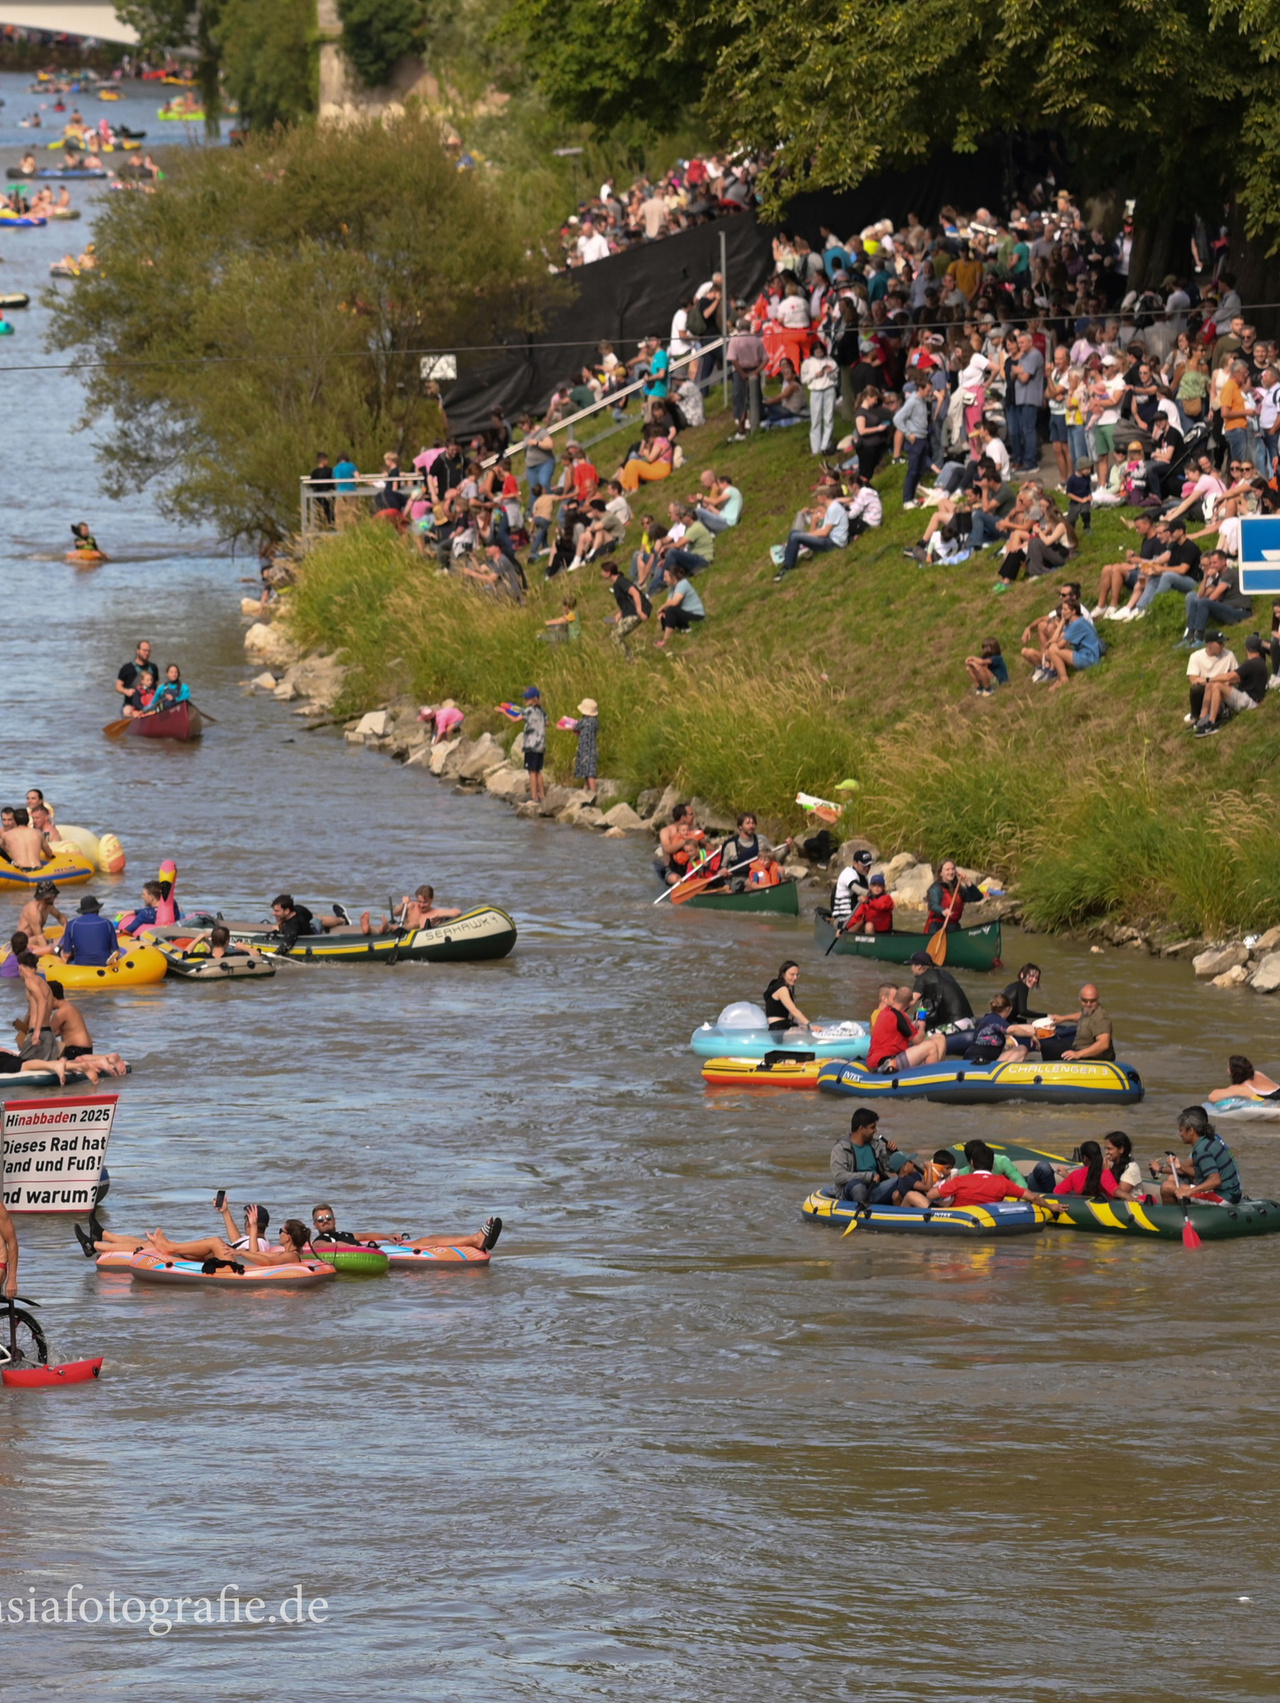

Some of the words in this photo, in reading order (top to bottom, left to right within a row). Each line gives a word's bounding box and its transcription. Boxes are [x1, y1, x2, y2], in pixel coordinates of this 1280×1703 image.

[1008, 1063, 1097, 1075] CHALLENGER
[5, 1112, 77, 1127] Hinabbaden
[79, 1108, 110, 1122] 2025
[0, 1140, 46, 1155] Dieses
[50, 1137, 78, 1152] Rad
[81, 1136, 106, 1150] hat
[35, 1157, 63, 1172] und
[67, 1156, 102, 1171] Fuß!
[26, 1186, 98, 1204] warum?
